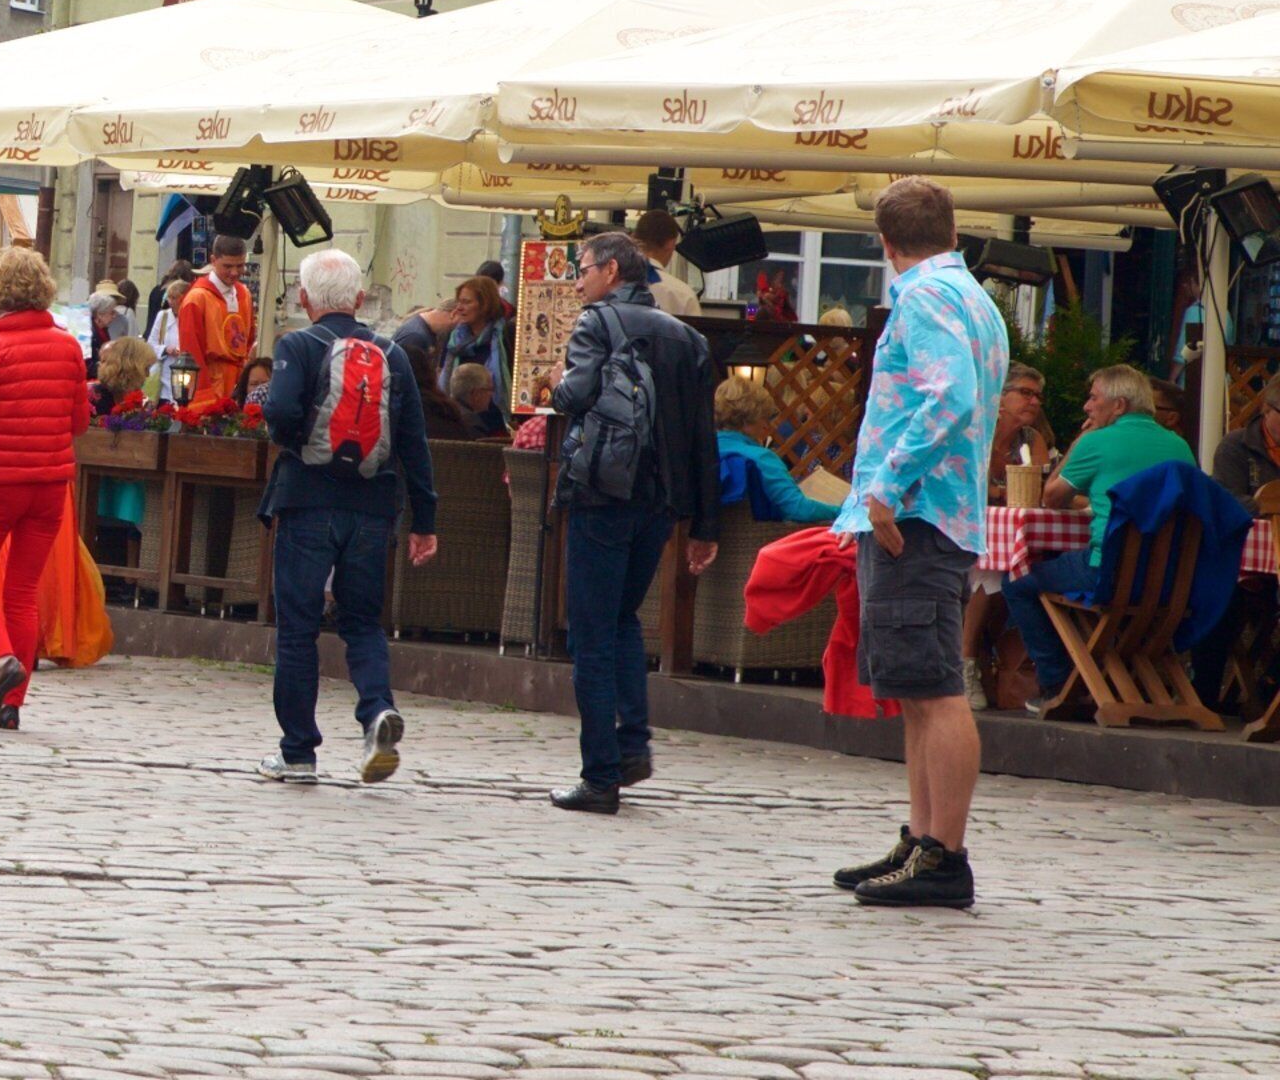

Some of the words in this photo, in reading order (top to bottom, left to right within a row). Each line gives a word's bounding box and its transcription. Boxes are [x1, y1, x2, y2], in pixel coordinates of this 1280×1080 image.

[297, 105, 337, 135] saku
[528, 88, 577, 121] saku
[662, 89, 707, 125] saku
[793, 90, 844, 125] saku
[14, 112, 44, 141] saku
[103, 114, 134, 145] saku
[196, 110, 231, 141] saku
